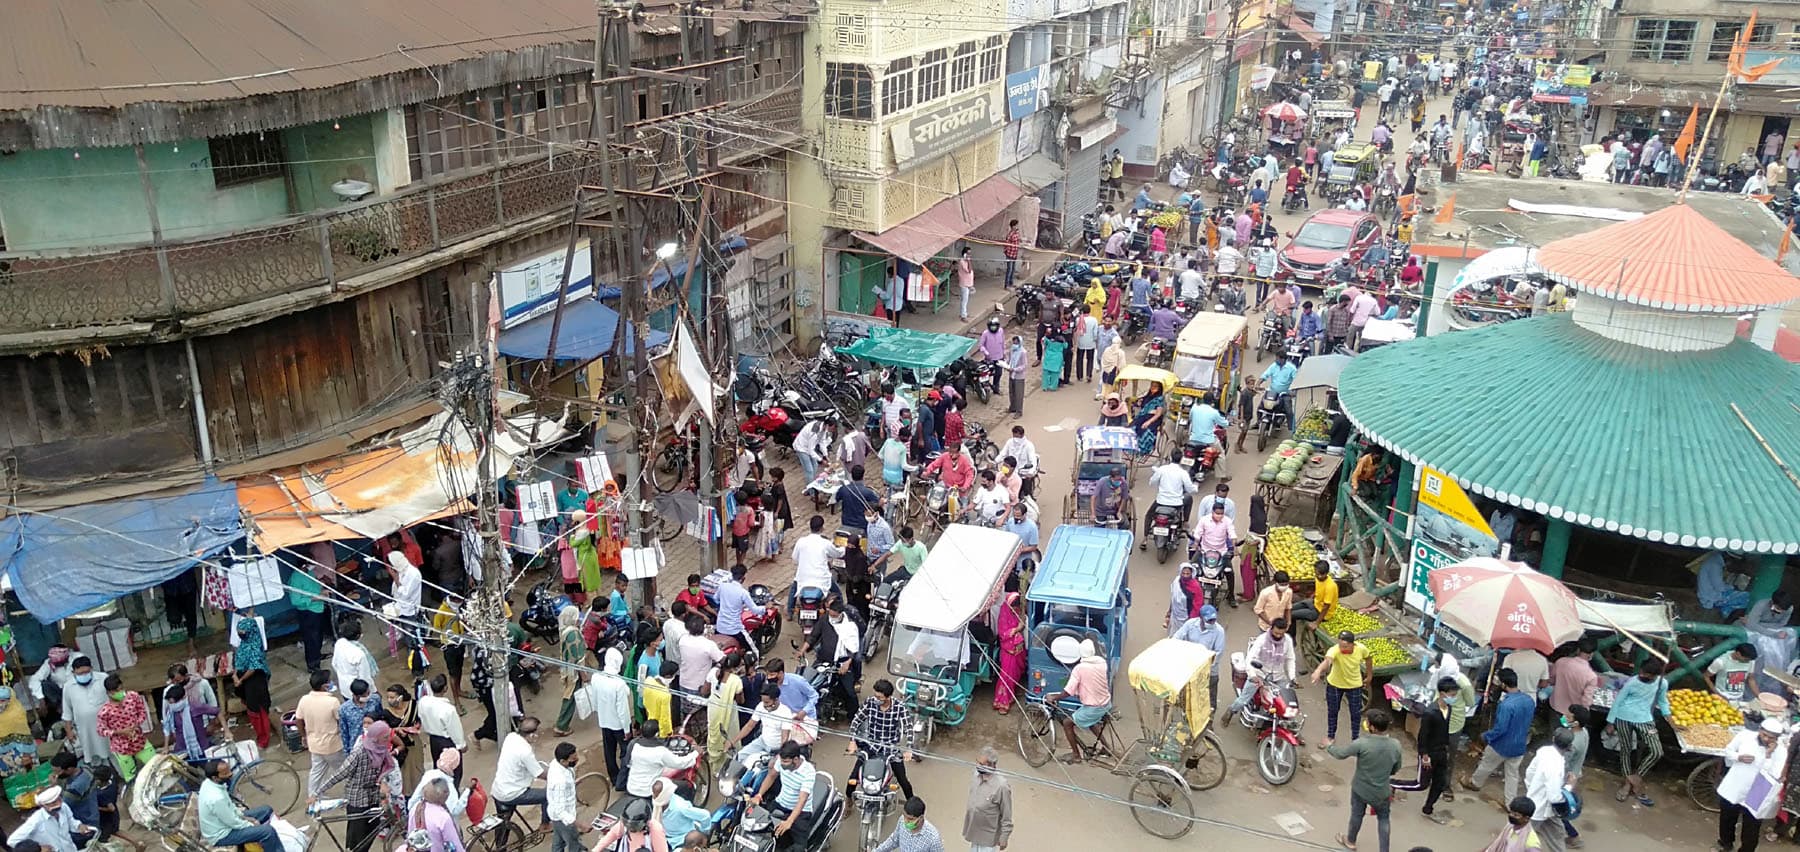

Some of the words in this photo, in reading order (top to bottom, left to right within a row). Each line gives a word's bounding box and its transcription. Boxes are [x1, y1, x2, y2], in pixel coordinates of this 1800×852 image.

[914, 97, 987, 143] सोलंकी
[1507, 611, 1536, 625] airtel
[1512, 623, 1530, 634] 4G
